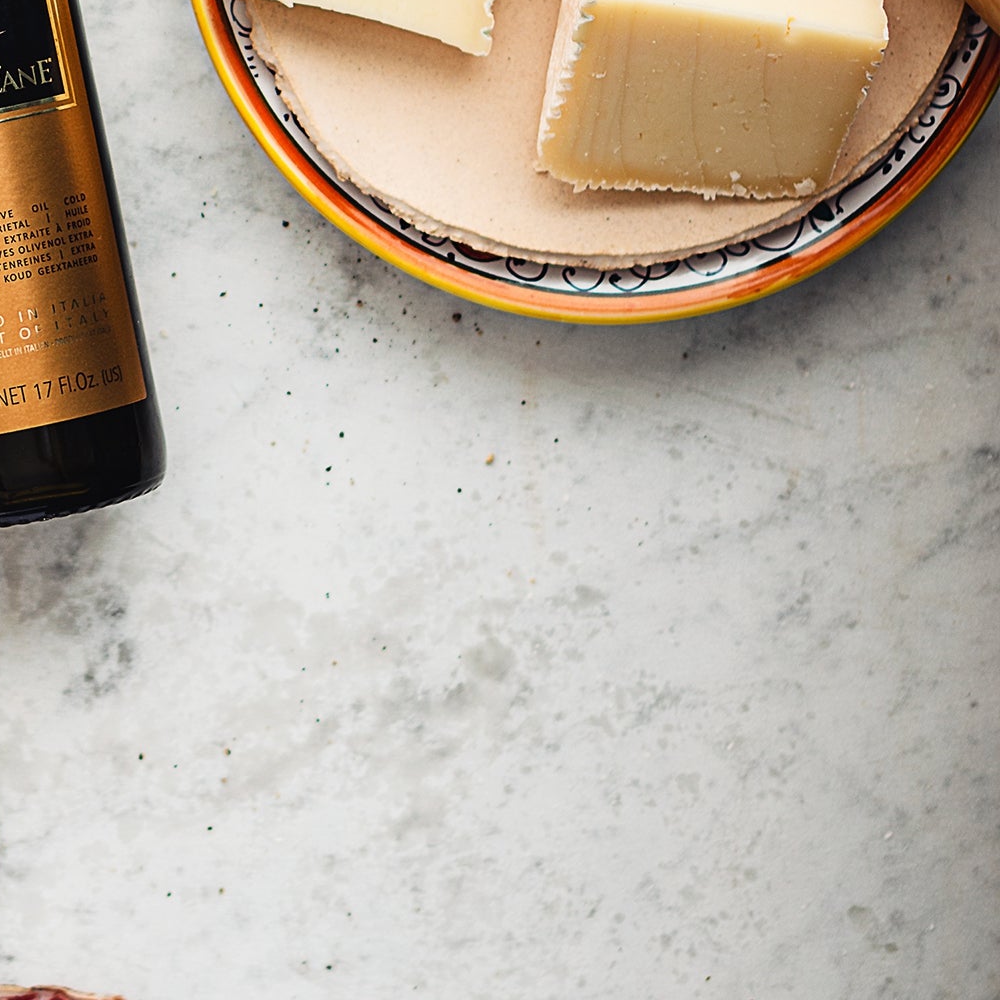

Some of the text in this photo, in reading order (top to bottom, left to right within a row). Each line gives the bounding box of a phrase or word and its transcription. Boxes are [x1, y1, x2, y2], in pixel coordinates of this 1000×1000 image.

[31, 202, 49, 212] OIL
[63, 193, 86, 206] COLD
[65, 205, 88, 218] HUILE
[4, 227, 51, 245] EXTRAITE
[67, 217, 91, 231] FROID
[69, 230, 94, 243] EXTRA
[70, 242, 96, 255] EXTRA
[4, 271, 32, 283] KOUD
[38, 254, 98, 276] GEEXTAHEERD
[18, 308, 38, 322] IN
[52, 292, 106, 314] ITALIA
[55, 308, 108, 330] ITALY
[34, 380, 52, 400] 17
[101, 364, 122, 386] (US)
